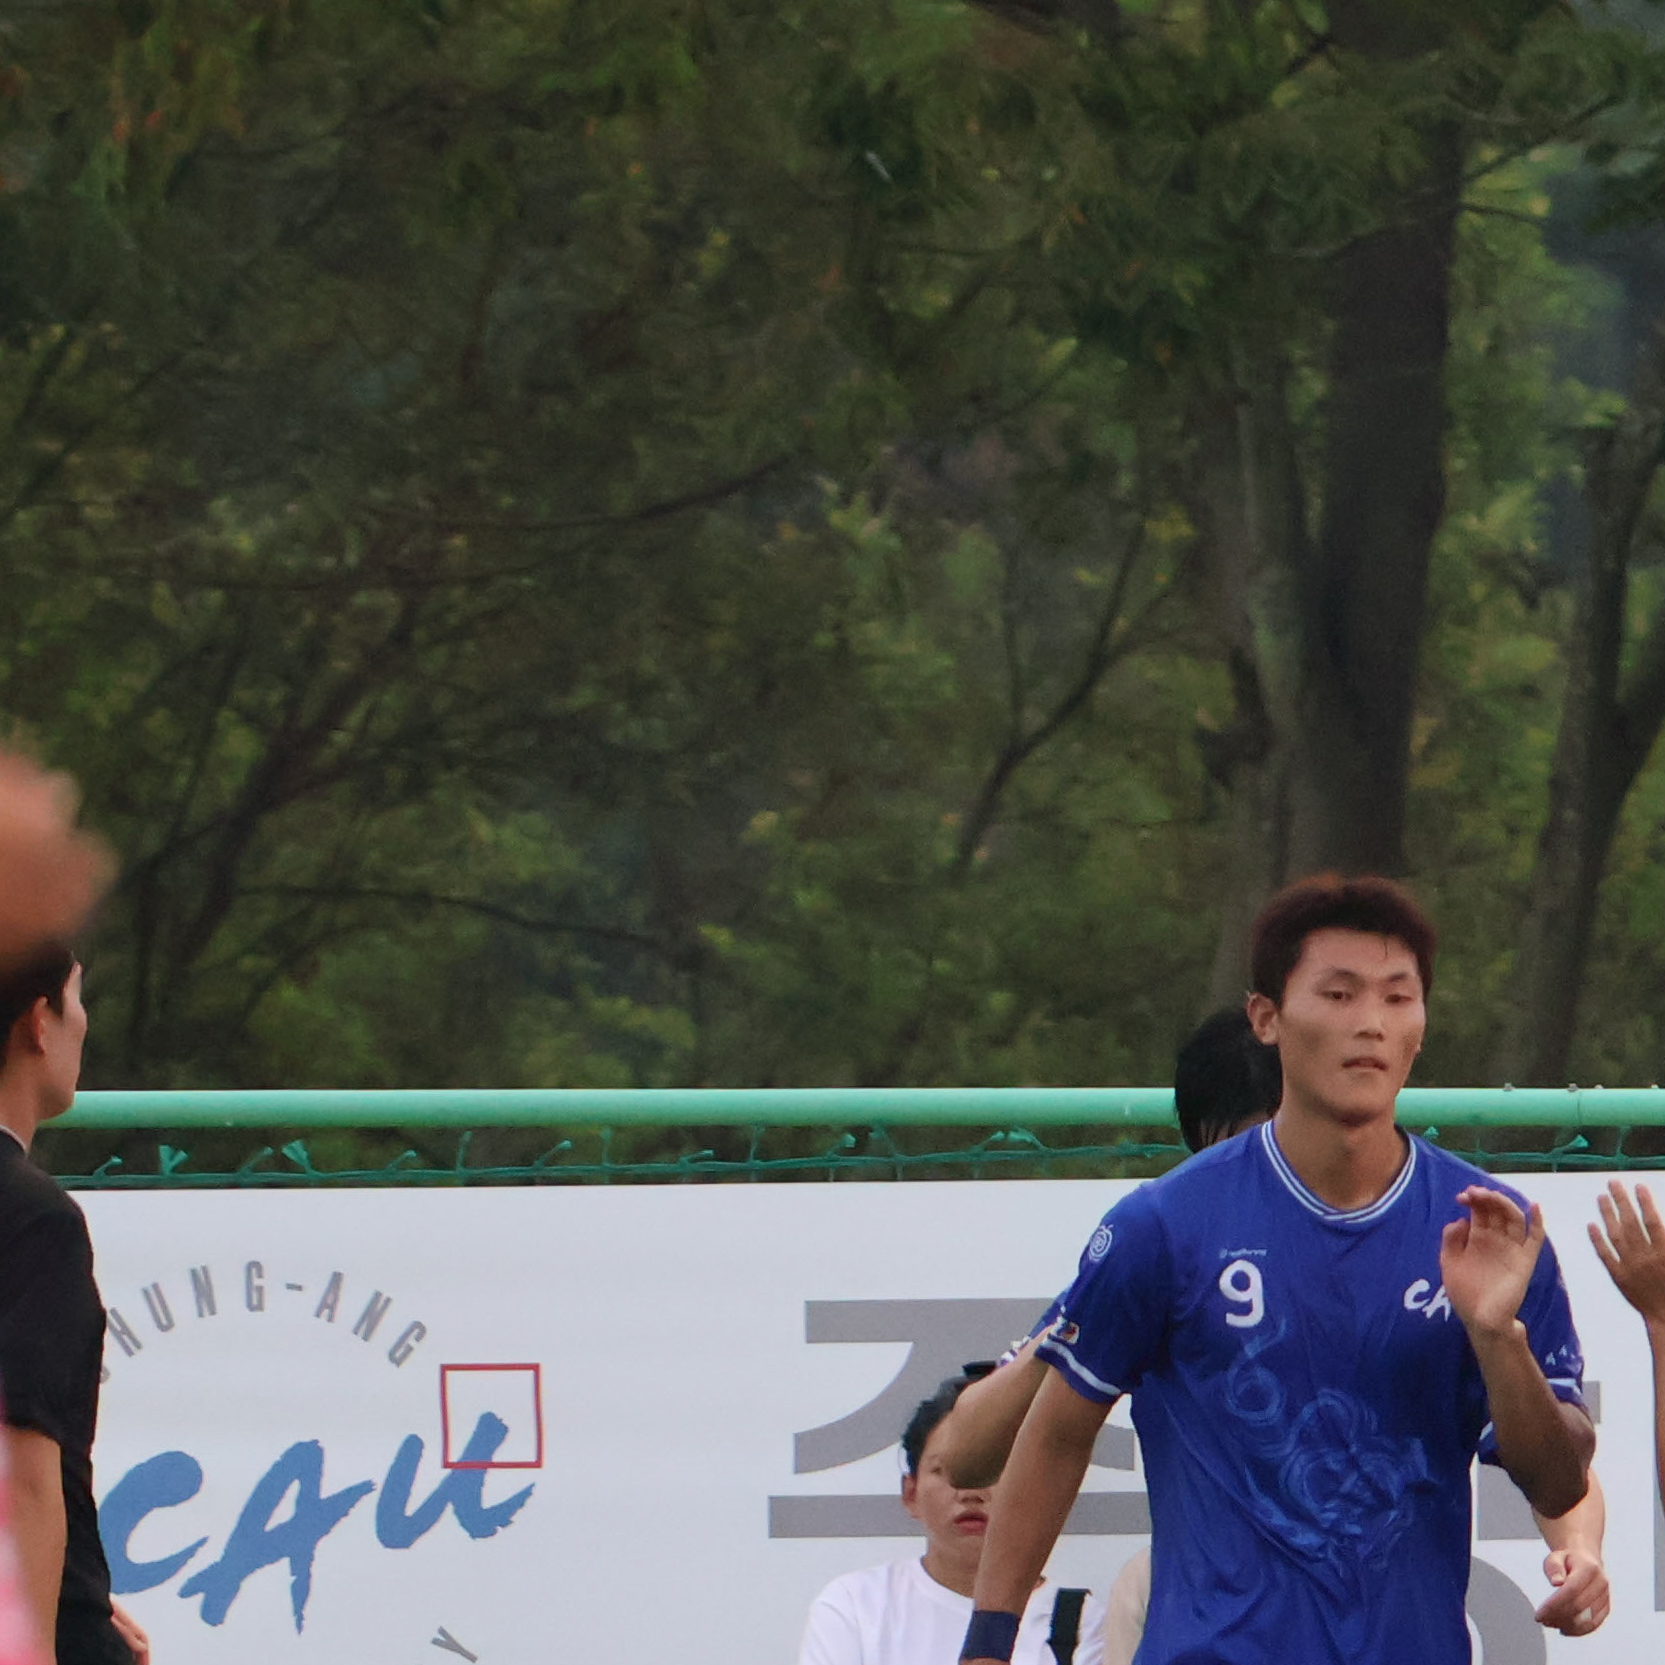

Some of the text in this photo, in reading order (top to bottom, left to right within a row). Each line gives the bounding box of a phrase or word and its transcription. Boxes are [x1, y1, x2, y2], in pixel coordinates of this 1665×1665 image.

[97, 1259, 428, 1386] HUNG-ANG
[1218, 1258, 1265, 1329] 9
[1403, 1278, 1452, 1322] CA
[98, 1411, 536, 1636] CAU
